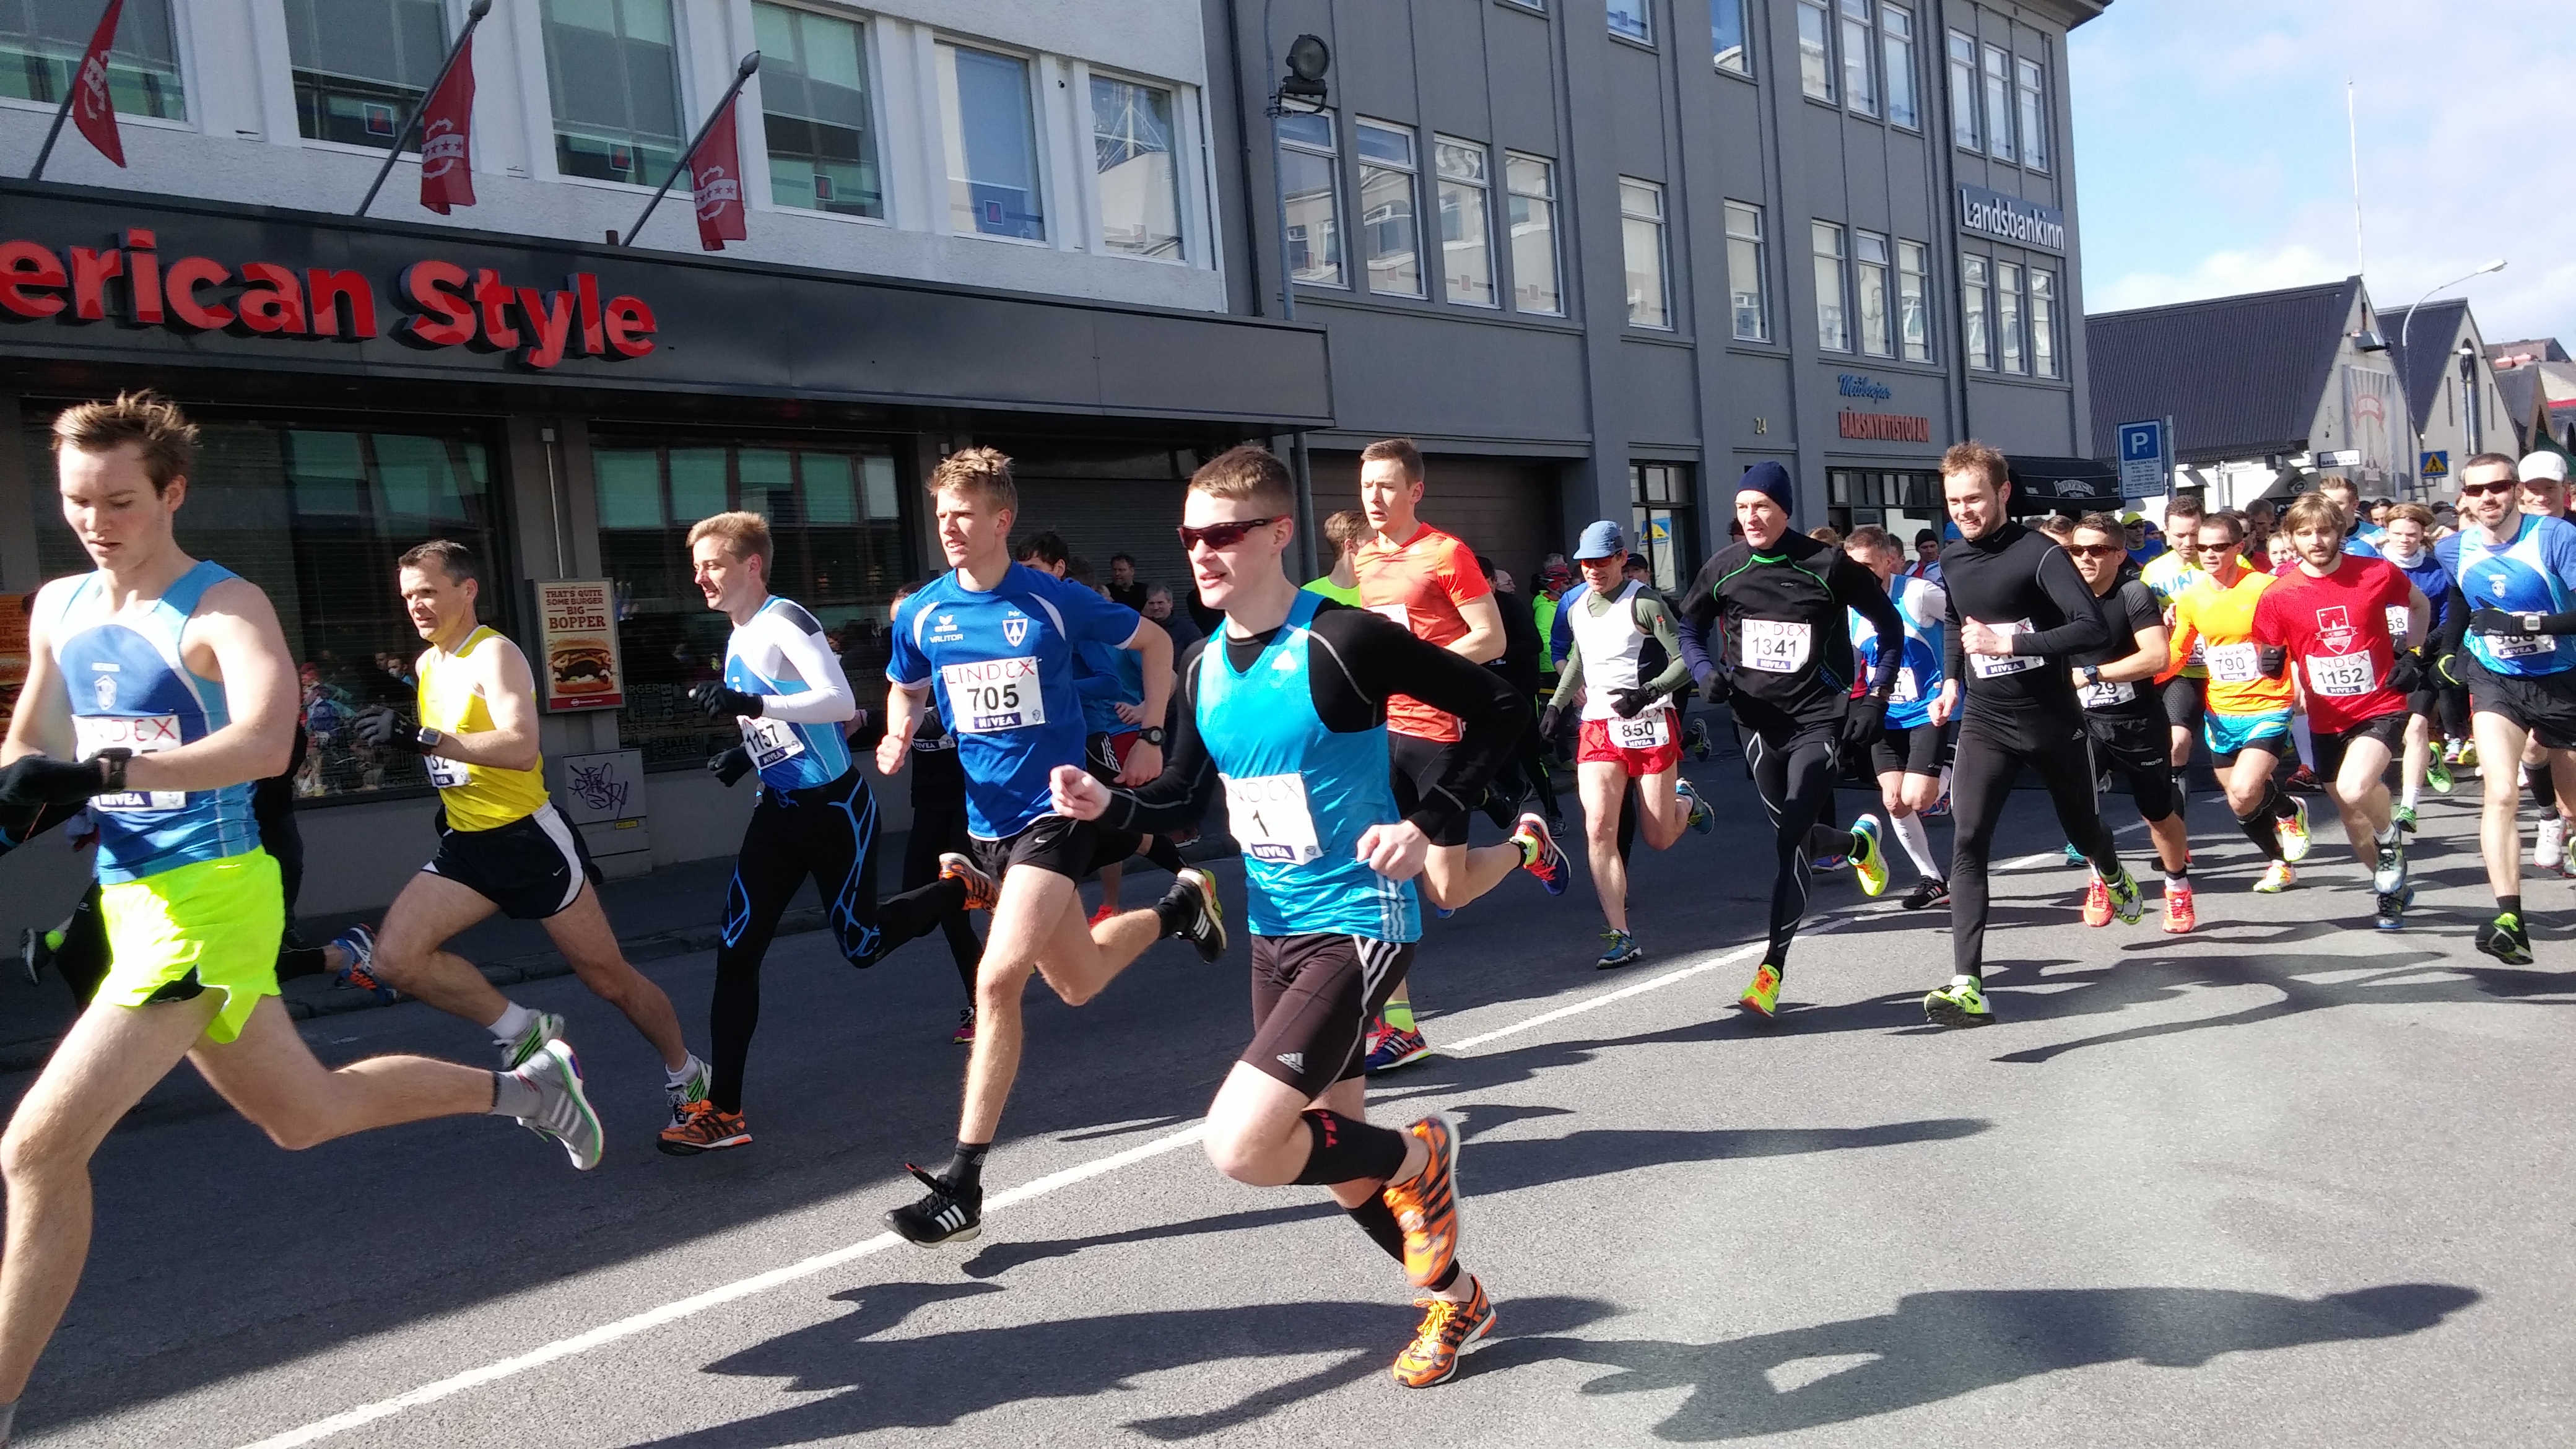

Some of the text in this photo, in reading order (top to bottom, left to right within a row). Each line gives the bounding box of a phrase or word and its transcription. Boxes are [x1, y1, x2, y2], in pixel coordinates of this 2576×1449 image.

[1960, 188, 2065, 250] Landsbankinn
[401, 259, 658, 369] Style
[1755, 417, 1767, 434] 24
[2131, 432, 2149, 455] P
[2150, 570, 2193, 598] RUN
[546, 590, 575, 598] THAT'S
[546, 597, 603, 606] SOME BURGER
[566, 606, 585, 615] BIG
[548, 616, 606, 629] BOPPER
[1752, 637, 1796, 658] 1341
[2502, 646, 2533, 655] NIVEA
[1760, 659, 1787, 669] NIVEA
[2215, 657, 2245, 671] 790
[2308, 653, 2369, 668] LNDEX
[945, 659, 1035, 685] LINDEX
[1990, 663, 2021, 674] NIVEA
[2318, 668, 2365, 685] 1152
[967, 683, 1019, 711] 705
[978, 715, 1016, 728] NIVEA
[1622, 721, 1654, 737] 850
[746, 724, 779, 753] 1157
[762, 751, 784, 764] NIVEA
[1252, 809, 1269, 837] 1
[1253, 846, 1291, 858] NIVEA
